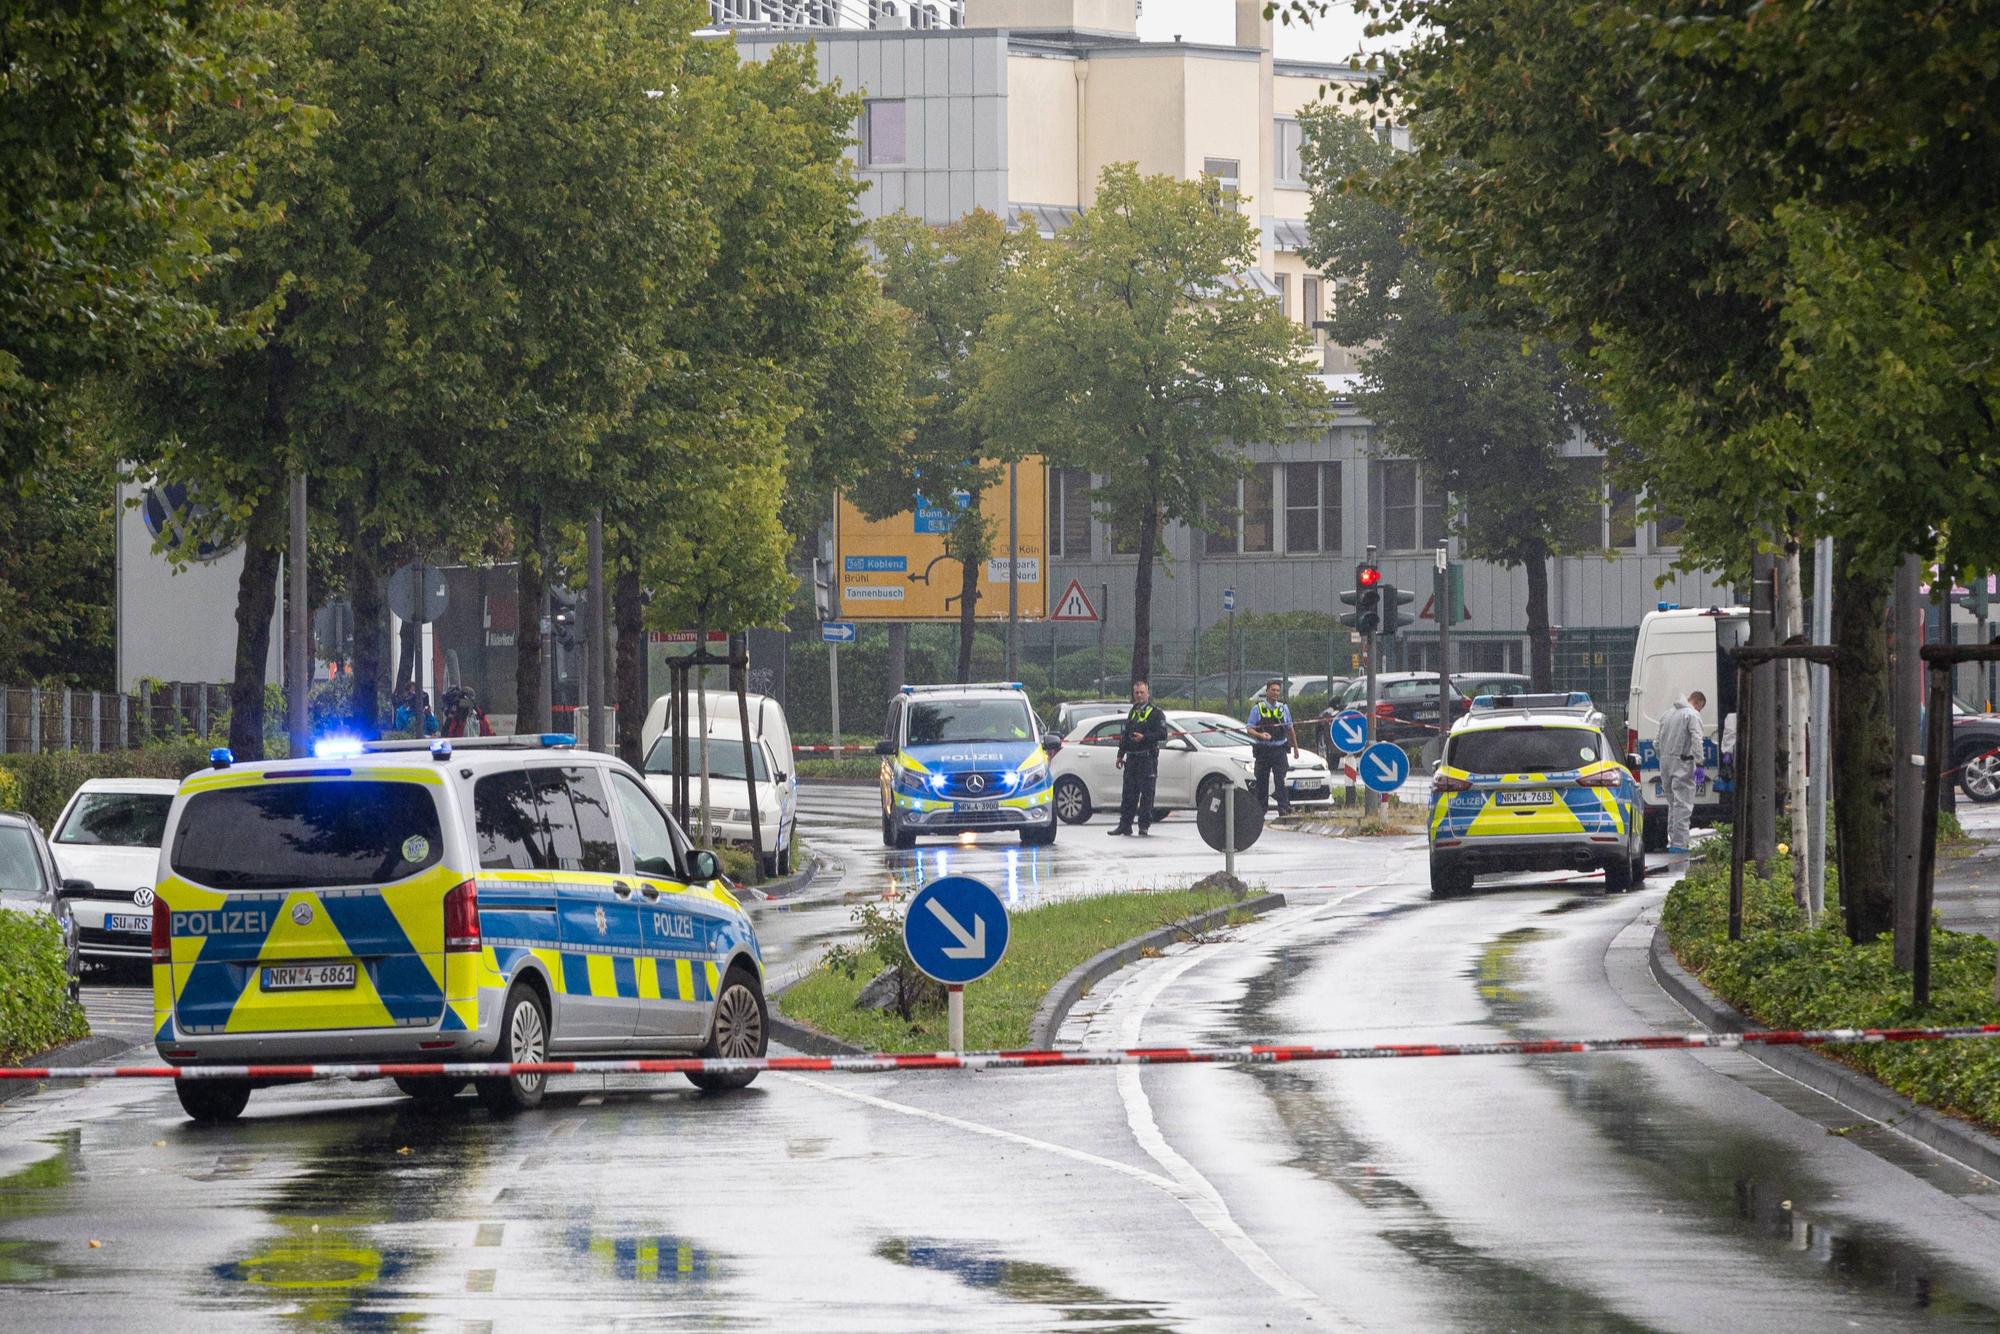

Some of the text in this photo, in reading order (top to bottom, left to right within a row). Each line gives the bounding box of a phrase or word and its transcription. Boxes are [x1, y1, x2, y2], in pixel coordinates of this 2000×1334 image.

[919, 509, 943, 518] Bonn
[1019, 545, 1040, 554] Köln
[867, 559, 904, 569] Koblenz
[844, 573, 869, 583] Brühl
[846, 588, 903, 598] Tannenbusch
[940, 753, 1003, 762] POLIZEI
[1450, 798, 1484, 806] POLIZEI
[1502, 792, 1518, 803] NRW
[112, 916, 148, 930] SU RS
[173, 911, 267, 935] POLIZEI
[653, 912, 694, 939] POLIZEI
[269, 968, 296, 985] NRW
